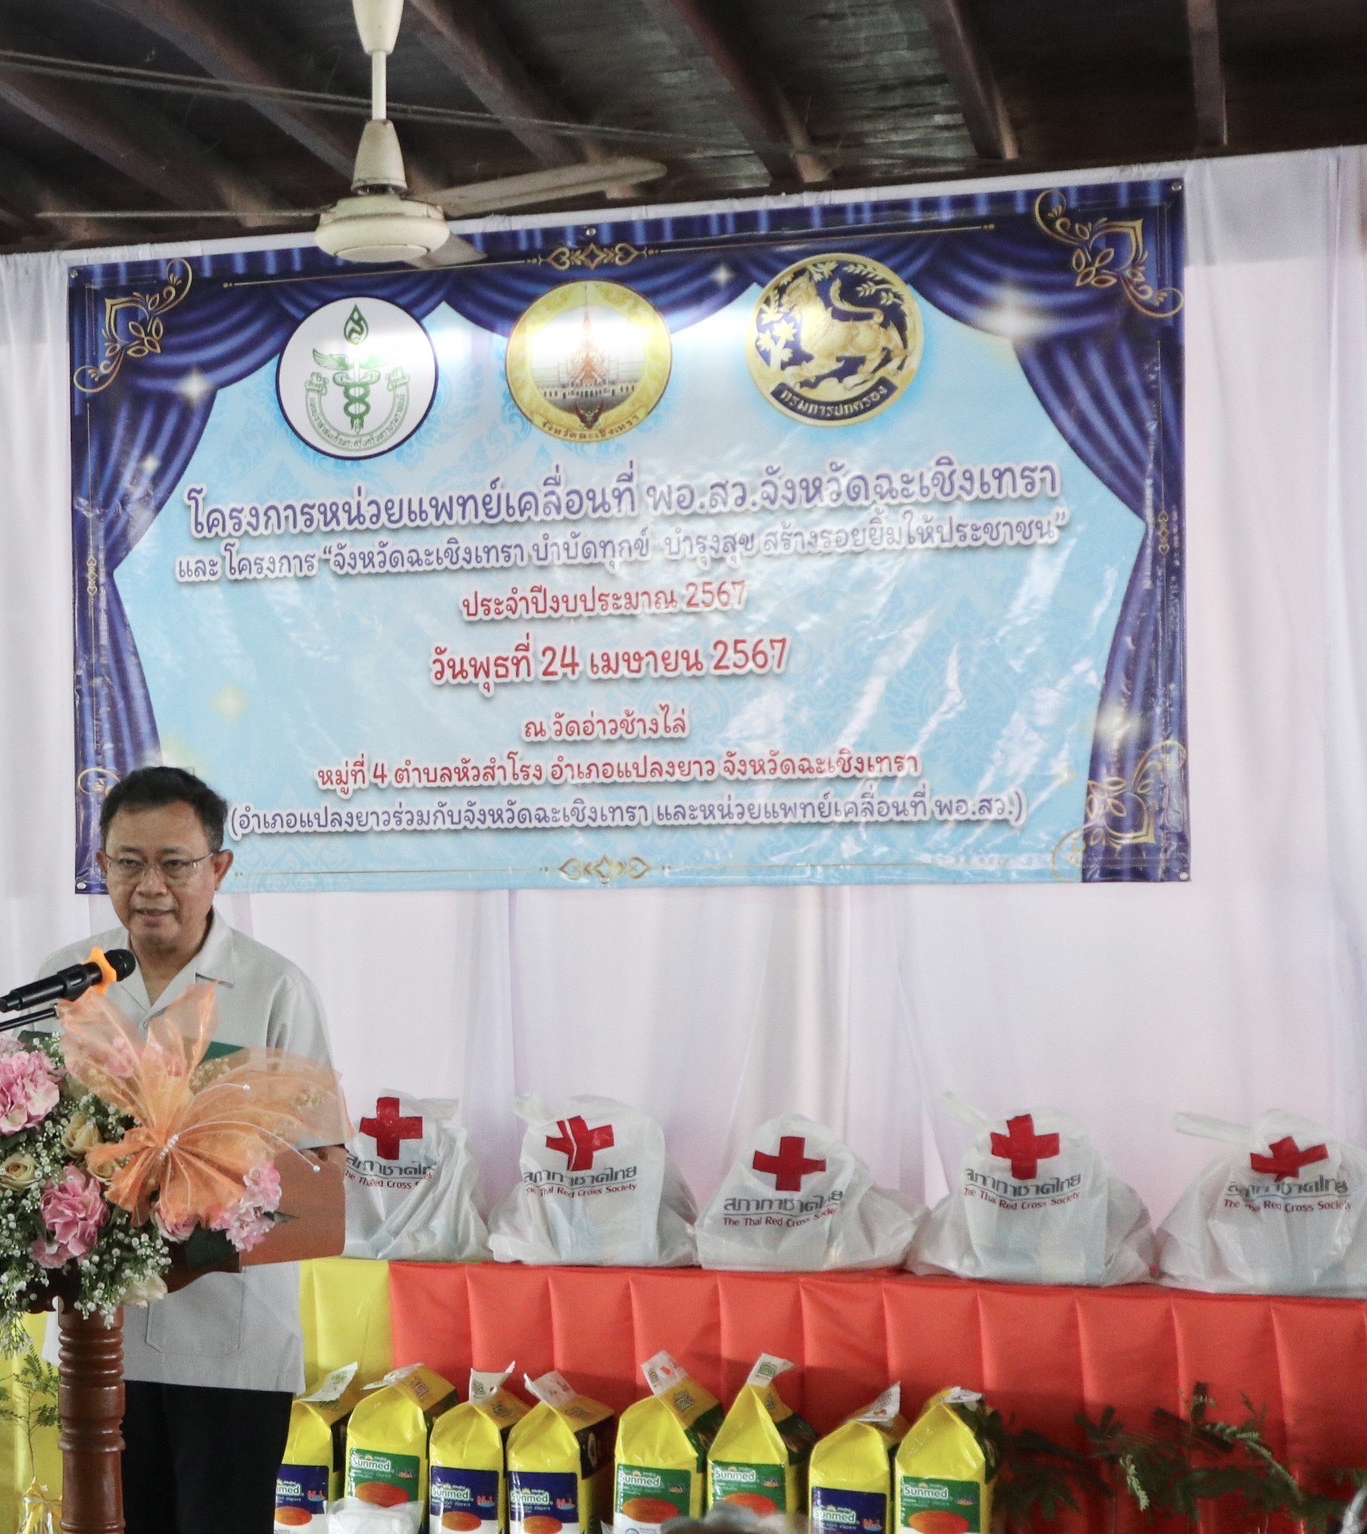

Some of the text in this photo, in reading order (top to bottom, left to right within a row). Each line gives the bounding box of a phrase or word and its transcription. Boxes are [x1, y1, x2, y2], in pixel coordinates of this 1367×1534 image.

[187, 460, 634, 533] โครงการหน่วยแพทย์เคลื่อนที่
[178, 558, 219, 579] และ
[224, 541, 316, 576] โครงการ
[534, 526, 650, 569] บำบัดทุกข์
[664, 527, 755, 566] บำรุงสุข
[463, 581, 746, 618] ประจำปีงบประมาณ 2567
[431, 632, 787, 693] วันพุธที่ 24 เมษายน 2567
[553, 704, 687, 738] วัดอ่าวช้างไล่
[318, 748, 919, 795] หมู่ที่ 4 ตำบลหัวสำโรง อำเภอแปลงยาว จังหวัดฉะเชิงเทรา
[231, 784, 1024, 836] (อำเภอแปลงยาวร่วมกับจังหวัดฉะเชิงเทรา และหน่วยแพทย์เคลื่อนที่ พอ.สว.)
[387, 1180, 412, 1189] Cross
[578, 1189, 603, 1197] Cross
[605, 1183, 637, 1193] Society
[999, 1199, 1018, 1210] Red
[1021, 1201, 1047, 1210] Cross
[1050, 1190, 1081, 1206] Society
[1224, 1198, 1240, 1208] The
[1284, 1202, 1314, 1213] Cross
[723, 1217, 740, 1226] The
[744, 1217, 762, 1227] Thai
[765, 1216, 783, 1226] Red
[351, 1457, 391, 1472] Sunmed
[714, 1469, 756, 1482] Sunmed
[431, 1485, 470, 1500] Sunmed
[904, 1485, 949, 1499] Sunmed
